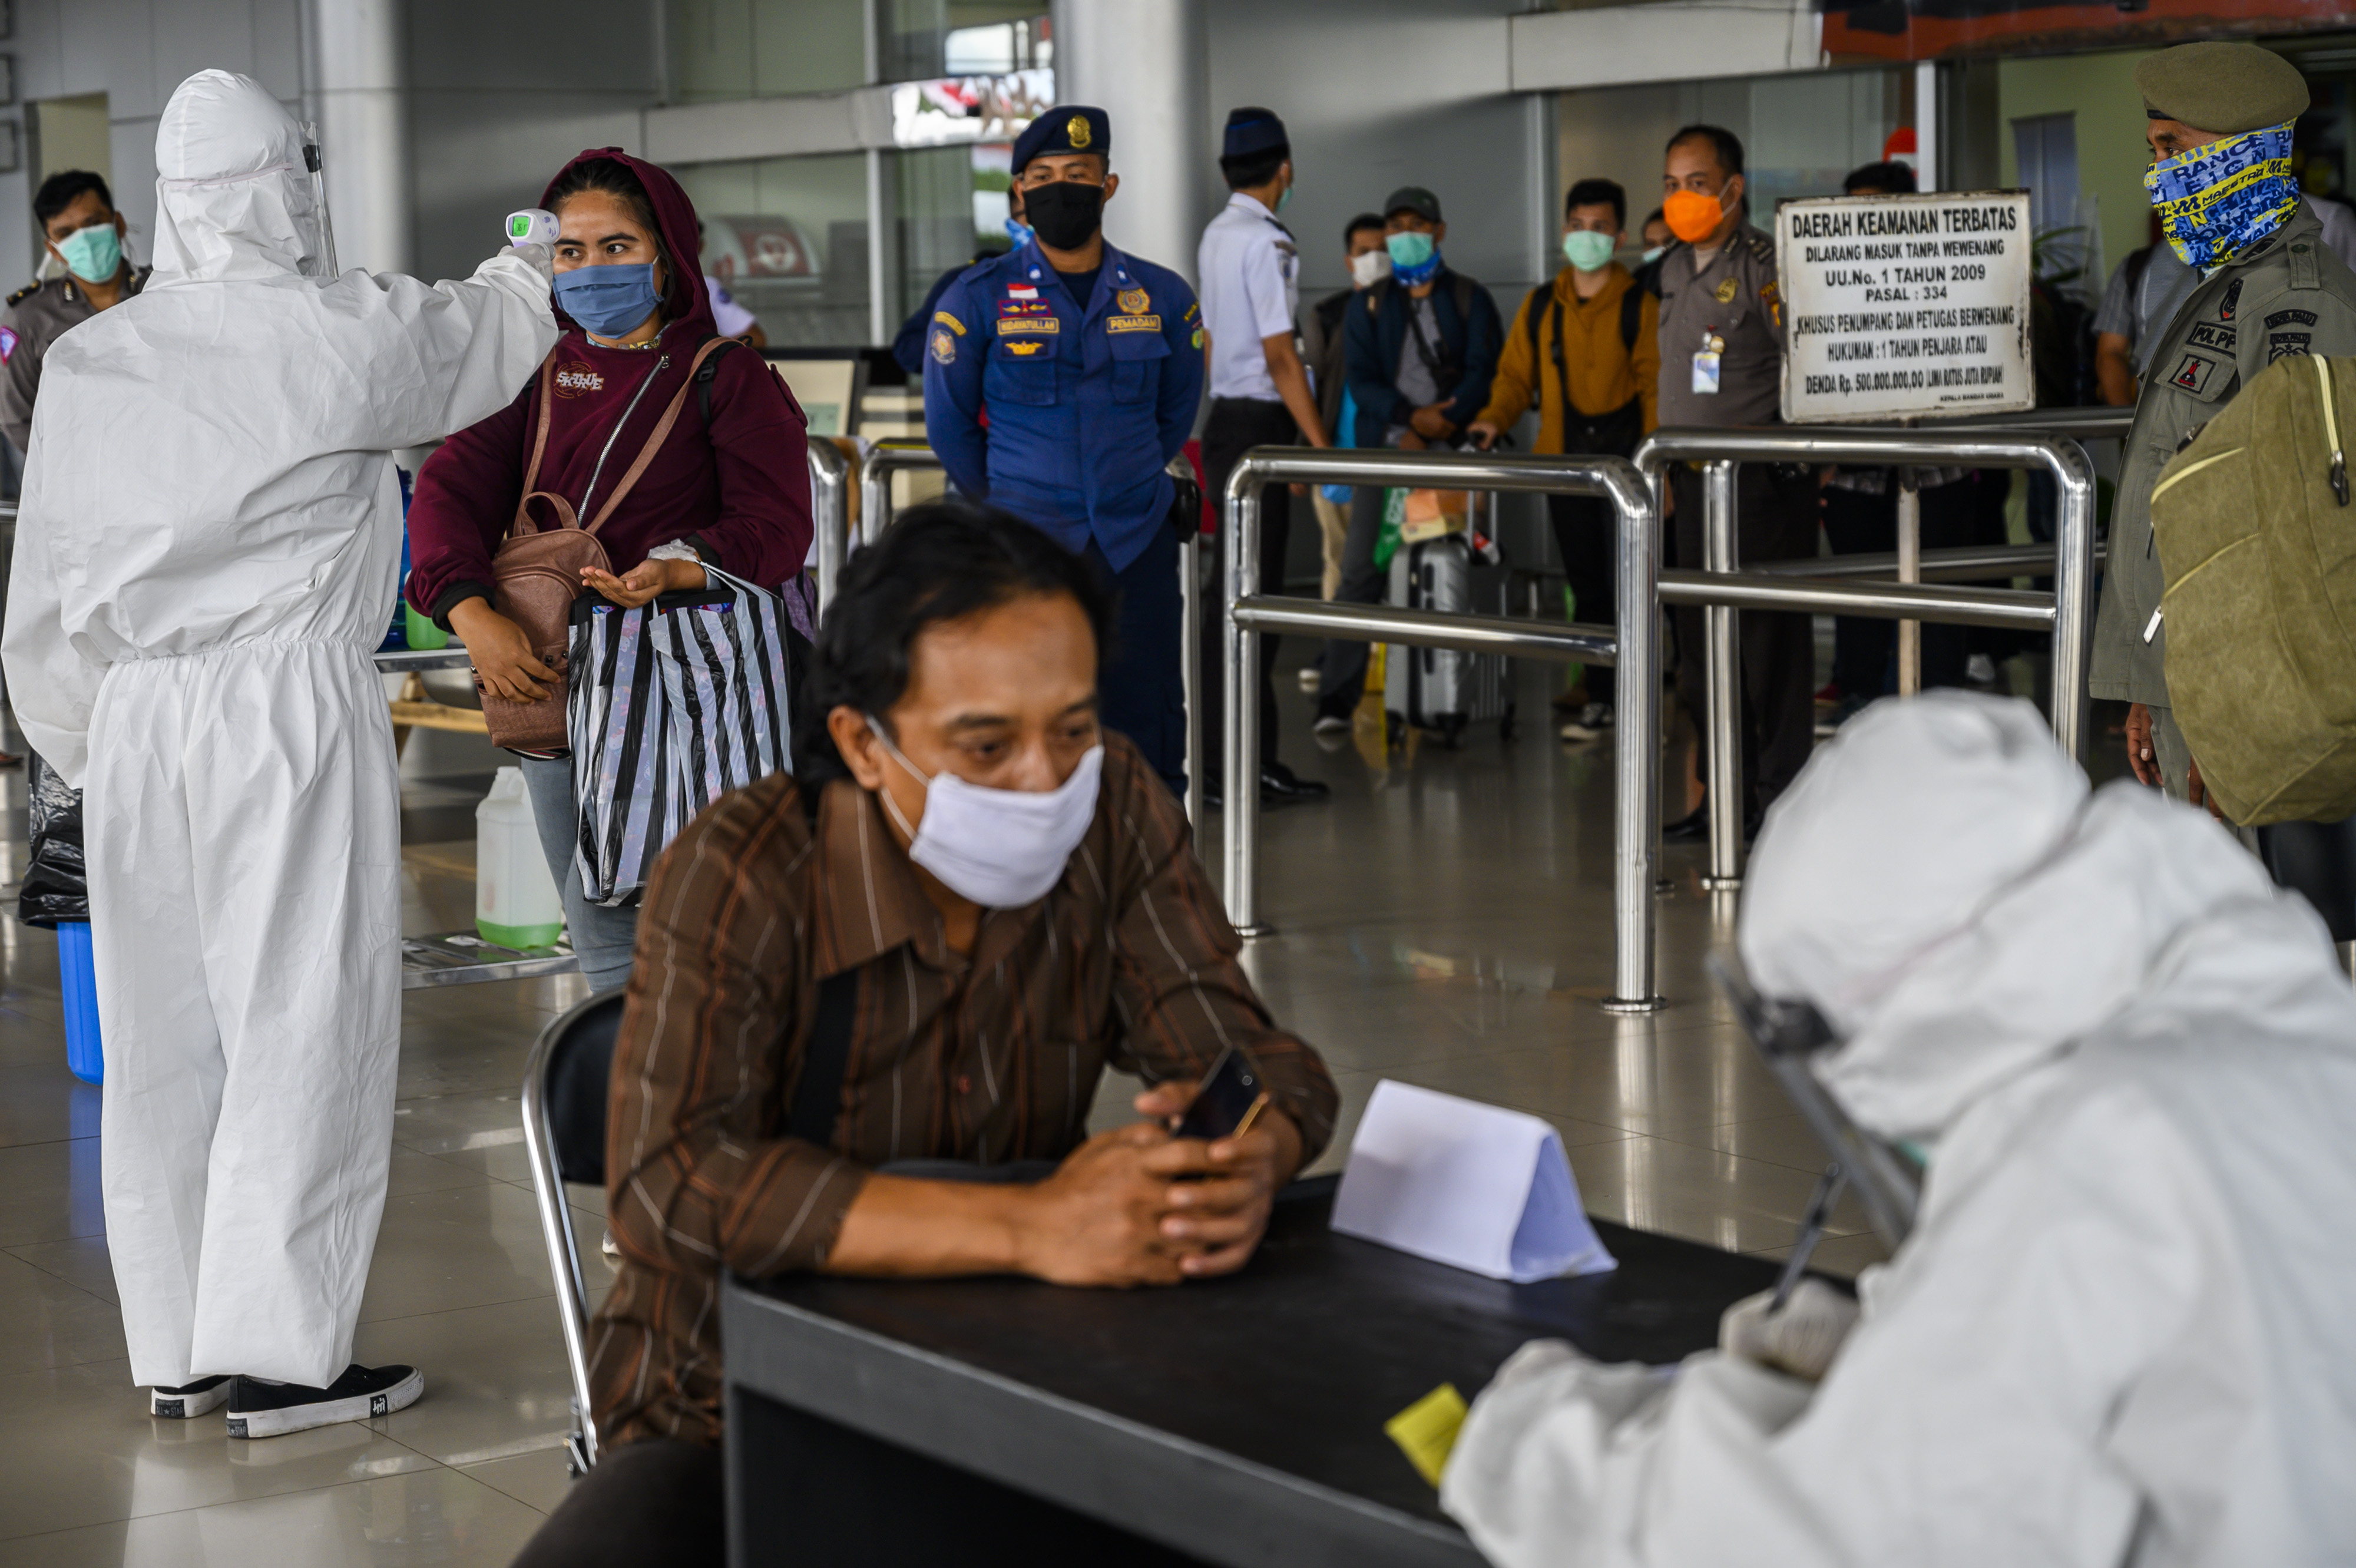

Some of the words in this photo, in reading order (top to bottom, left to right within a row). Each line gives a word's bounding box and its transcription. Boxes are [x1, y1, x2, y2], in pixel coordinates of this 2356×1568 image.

[1793, 212, 1852, 238] DAERAH
[1858, 209, 1939, 236] KEAMANAN
[1943, 206, 2017, 232] TERBATAS
[1806, 244, 1862, 262] DILARANG
[1865, 242, 1903, 260] MASUK
[1906, 241, 1940, 258] TANPA
[1943, 239, 2004, 256] WEWENANG
[1826, 269, 1876, 286] UU.No.
[1881, 267, 1889, 285] 1
[1895, 266, 1946, 283] TAHUN
[1951, 263, 1986, 280] 2009
[1865, 287, 1910, 302] PASAL
[1923, 285, 1948, 300] 334
[1798, 314, 1835, 335] KHUSUS
[1838, 310, 1894, 333] PENUMPANG
[1896, 310, 1914, 330] DAN
[1917, 307, 1958, 329] PETUGAS
[1960, 305, 2014, 326] BERWENANG
[1828, 340, 1874, 362] HUKUMAN
[1889, 338, 1920, 359] TAHUN
[1922, 335, 1963, 356] PENJARA
[1965, 334, 1987, 353] ATAU
[2193, 327, 2215, 344] POL
[2215, 331, 2236, 349] PP
[1806, 374, 1837, 395] DENDA
[1944, 368, 1964, 387] RATUS
[1964, 366, 1980, 385] JUTA
